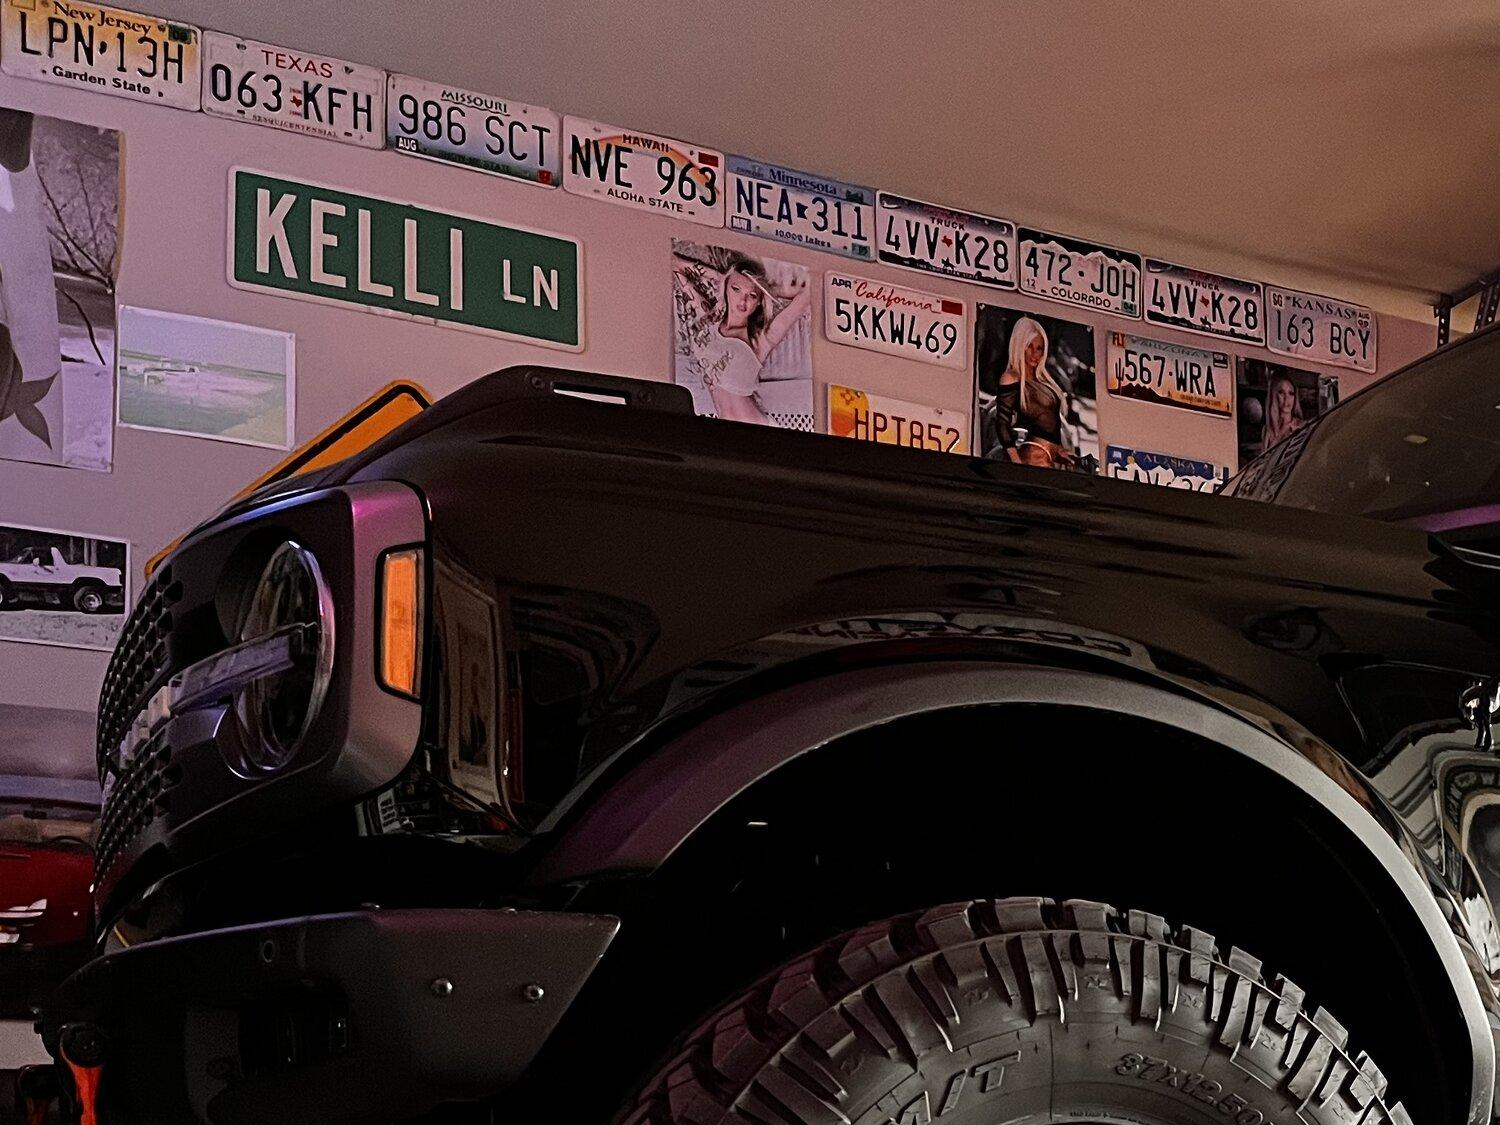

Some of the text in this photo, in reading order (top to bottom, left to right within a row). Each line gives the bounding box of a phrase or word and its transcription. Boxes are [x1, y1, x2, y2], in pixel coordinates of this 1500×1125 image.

[54, 1, 151, 36] New Jersey
[19, 11, 183, 84] LPN 13H
[261, 50, 333, 79] TEXAS
[53, 66, 151, 95] Garden State
[211, 64, 372, 133] 063 KFH
[442, 90, 509, 114] MISSOURI
[398, 138, 417, 151] AUG
[399, 94, 551, 167] 986 SCT
[622, 134, 669, 153] HAWAII
[571, 134, 717, 207] NVE 963
[769, 168, 837, 195] Minnesota
[607, 188, 683, 213] ALOHA STATE
[737, 178, 868, 242] NEA 311
[930, 216, 965, 231] TRUCK
[256, 187, 559, 311] KELLI LN
[886, 215, 1008, 273] 4VV K28
[1026, 247, 1072, 286] 472
[1026, 279, 1036, 288] 12
[831, 277, 942, 314] APR California
[1051, 286, 1111, 308] COLORADO
[1190, 279, 1220, 292] TRUCK
[1152, 279, 1258, 330] 4VV K28
[1272, 293, 1353, 320] SG KANSAS
[835, 298, 957, 356] 5KKW469
[1276, 309, 1370, 360] 163 BCY
[1125, 349, 1216, 398] 567 WRA
[854, 407, 960, 453] HPT852
[1144, 454, 1195, 470] ALASKA
